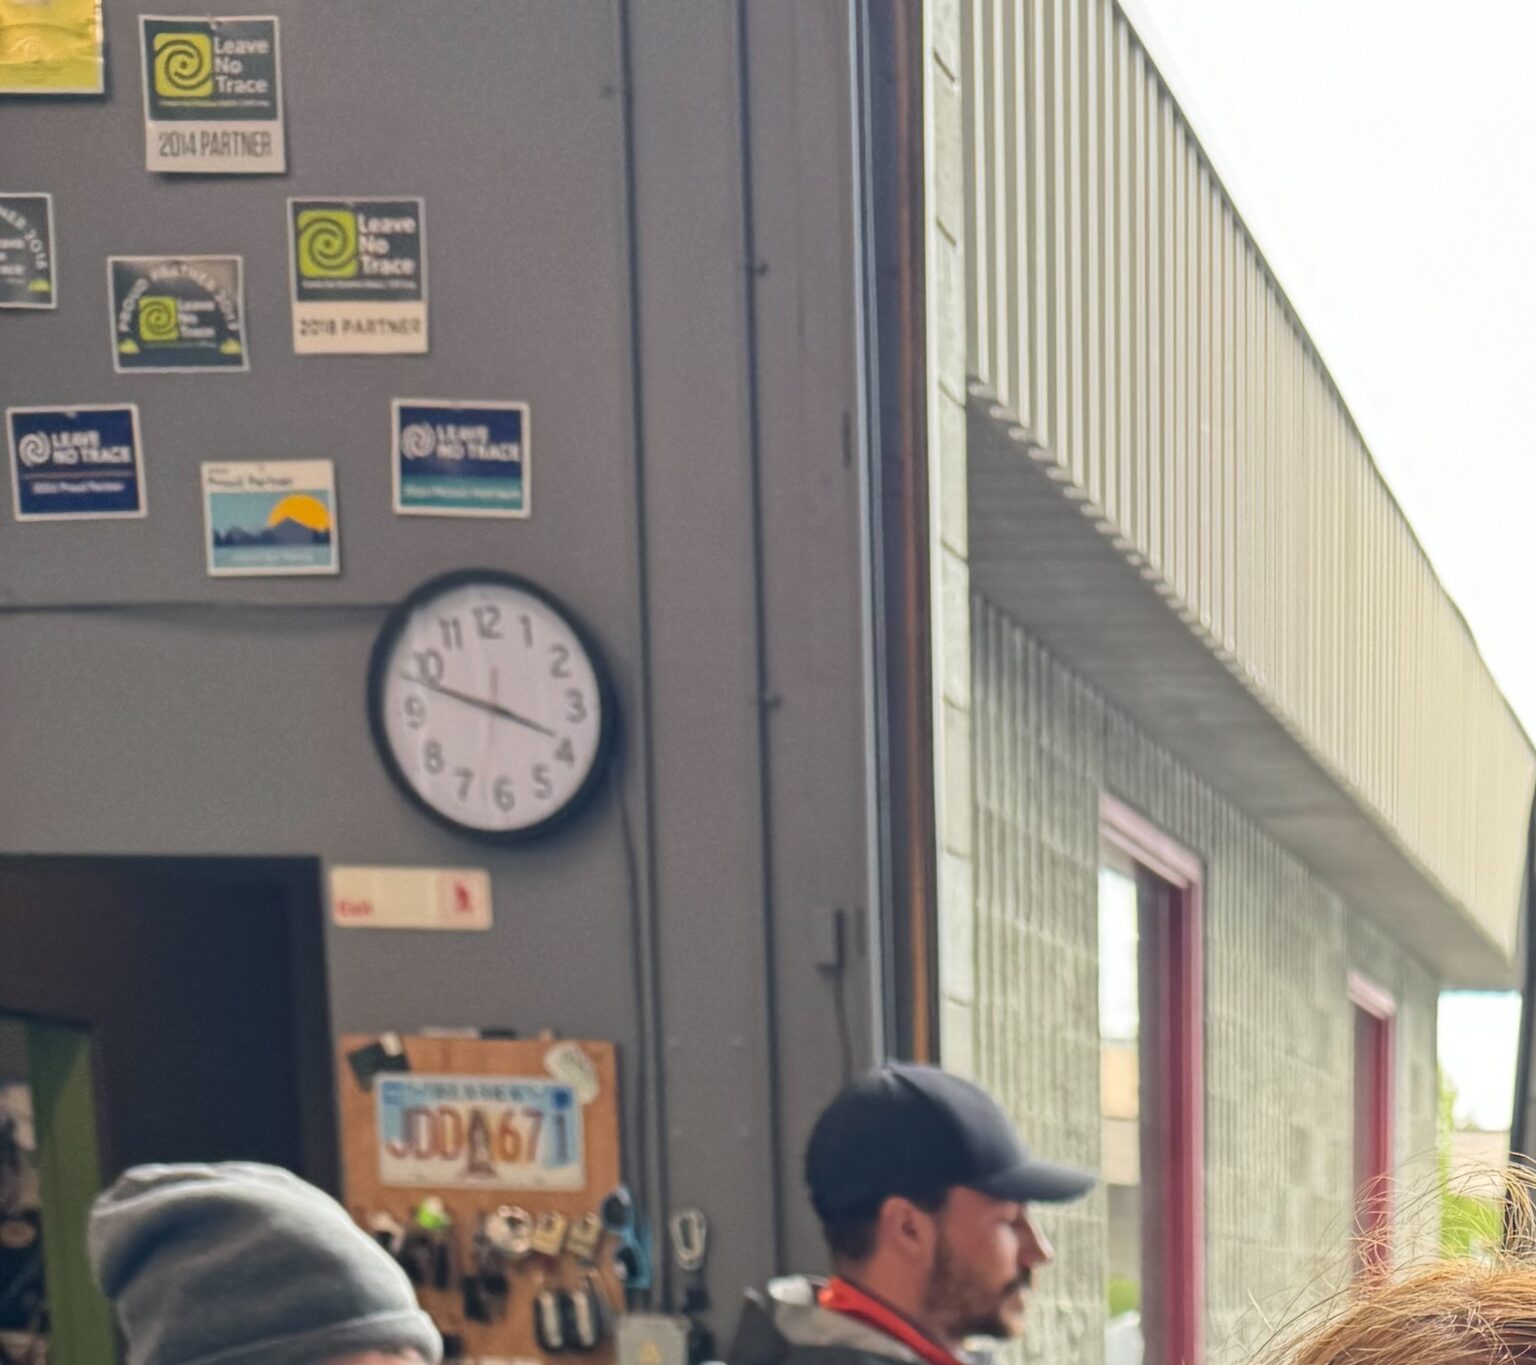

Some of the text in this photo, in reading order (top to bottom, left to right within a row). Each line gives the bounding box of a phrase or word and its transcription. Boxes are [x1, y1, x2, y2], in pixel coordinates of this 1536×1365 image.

[213, 36, 269, 54] Leave
[214, 56, 242, 74] No
[214, 76, 268, 93] Trace
[158, 131, 272, 157] 2014 PARTNER
[357, 212, 416, 234] Leave
[358, 234, 389, 255] No
[359, 255, 416, 275] Trace
[342, 317, 421, 335] PARTNER
[51, 430, 99, 448] LEAVE
[436, 424, 488, 442] LEAVE
[52, 446, 131, 464] NO TRACE
[467, 442, 520, 462] TRACE
[438, 617, 464, 650] 11
[473, 606, 502, 639] 12
[519, 614, 533, 648] 1
[550, 643, 571, 678] 2
[404, 695, 426, 729] 9
[565, 688, 586, 724] 3
[423, 740, 445, 774] 8
[553, 737, 574, 768] 4
[453, 766, 475, 801] 7
[493, 776, 516, 812] 6
[532, 763, 552, 799] 5
